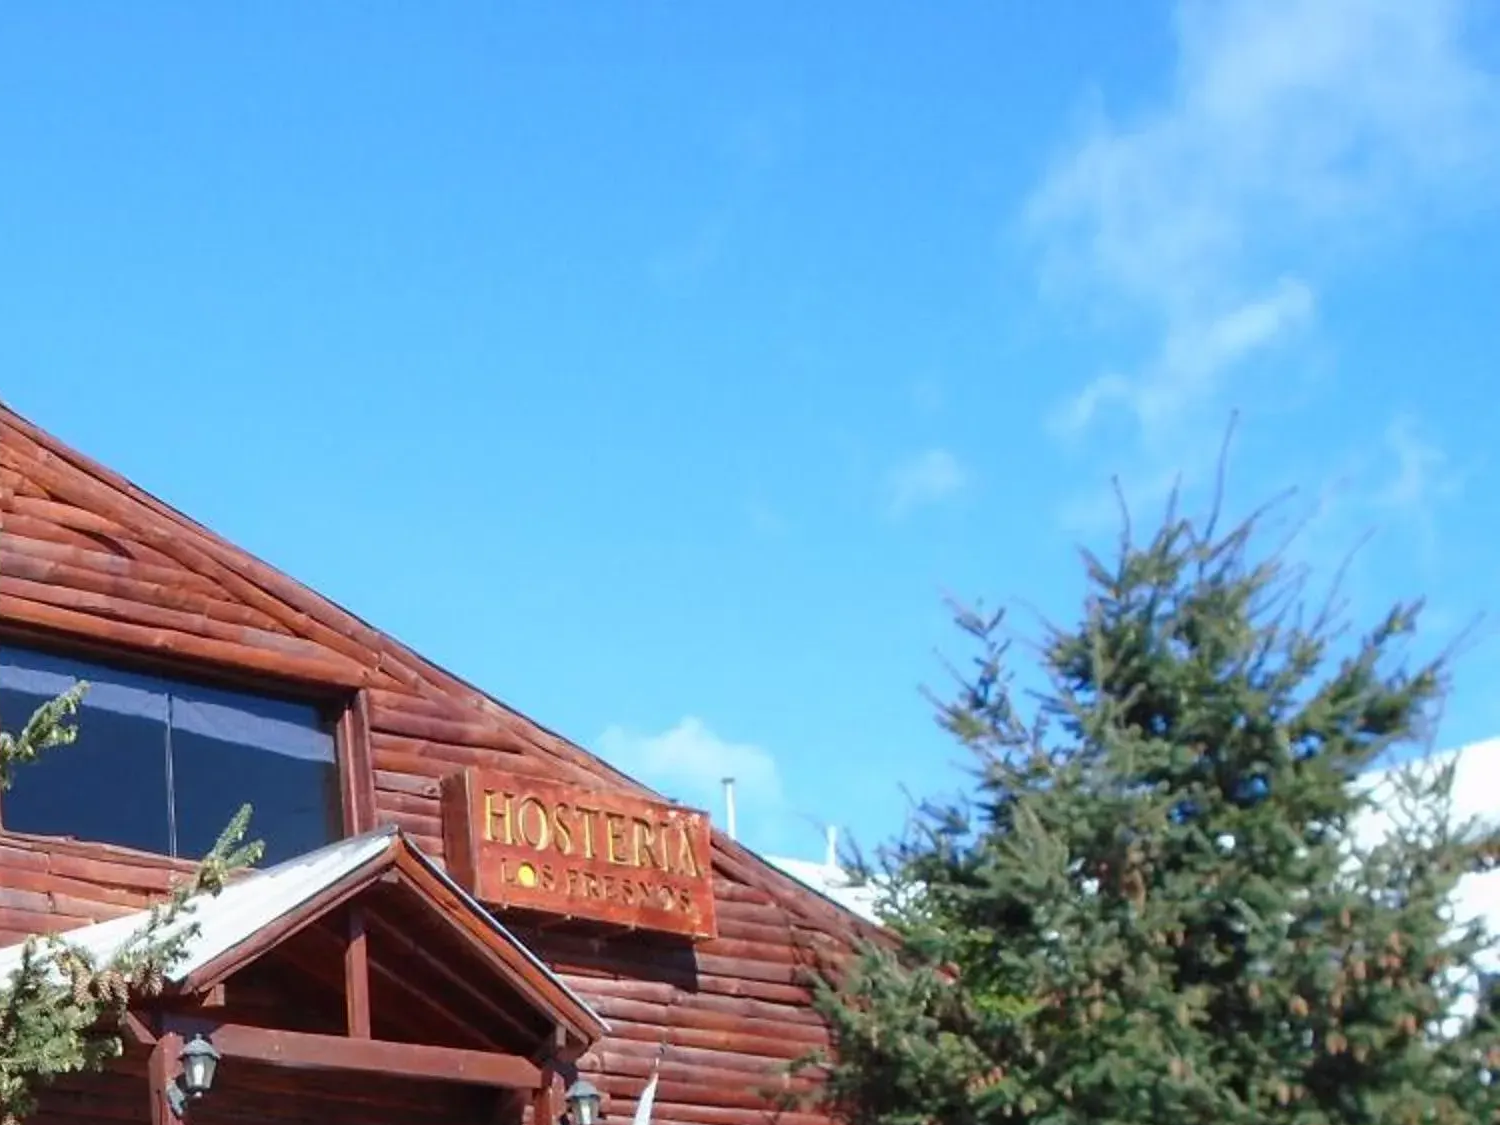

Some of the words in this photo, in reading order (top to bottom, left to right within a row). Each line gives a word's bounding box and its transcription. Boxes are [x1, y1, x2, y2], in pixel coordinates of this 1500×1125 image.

[484, 789, 702, 877] HOSTERIA
[501, 857, 555, 891] LOS
[566, 868, 693, 913] FRESNOS
